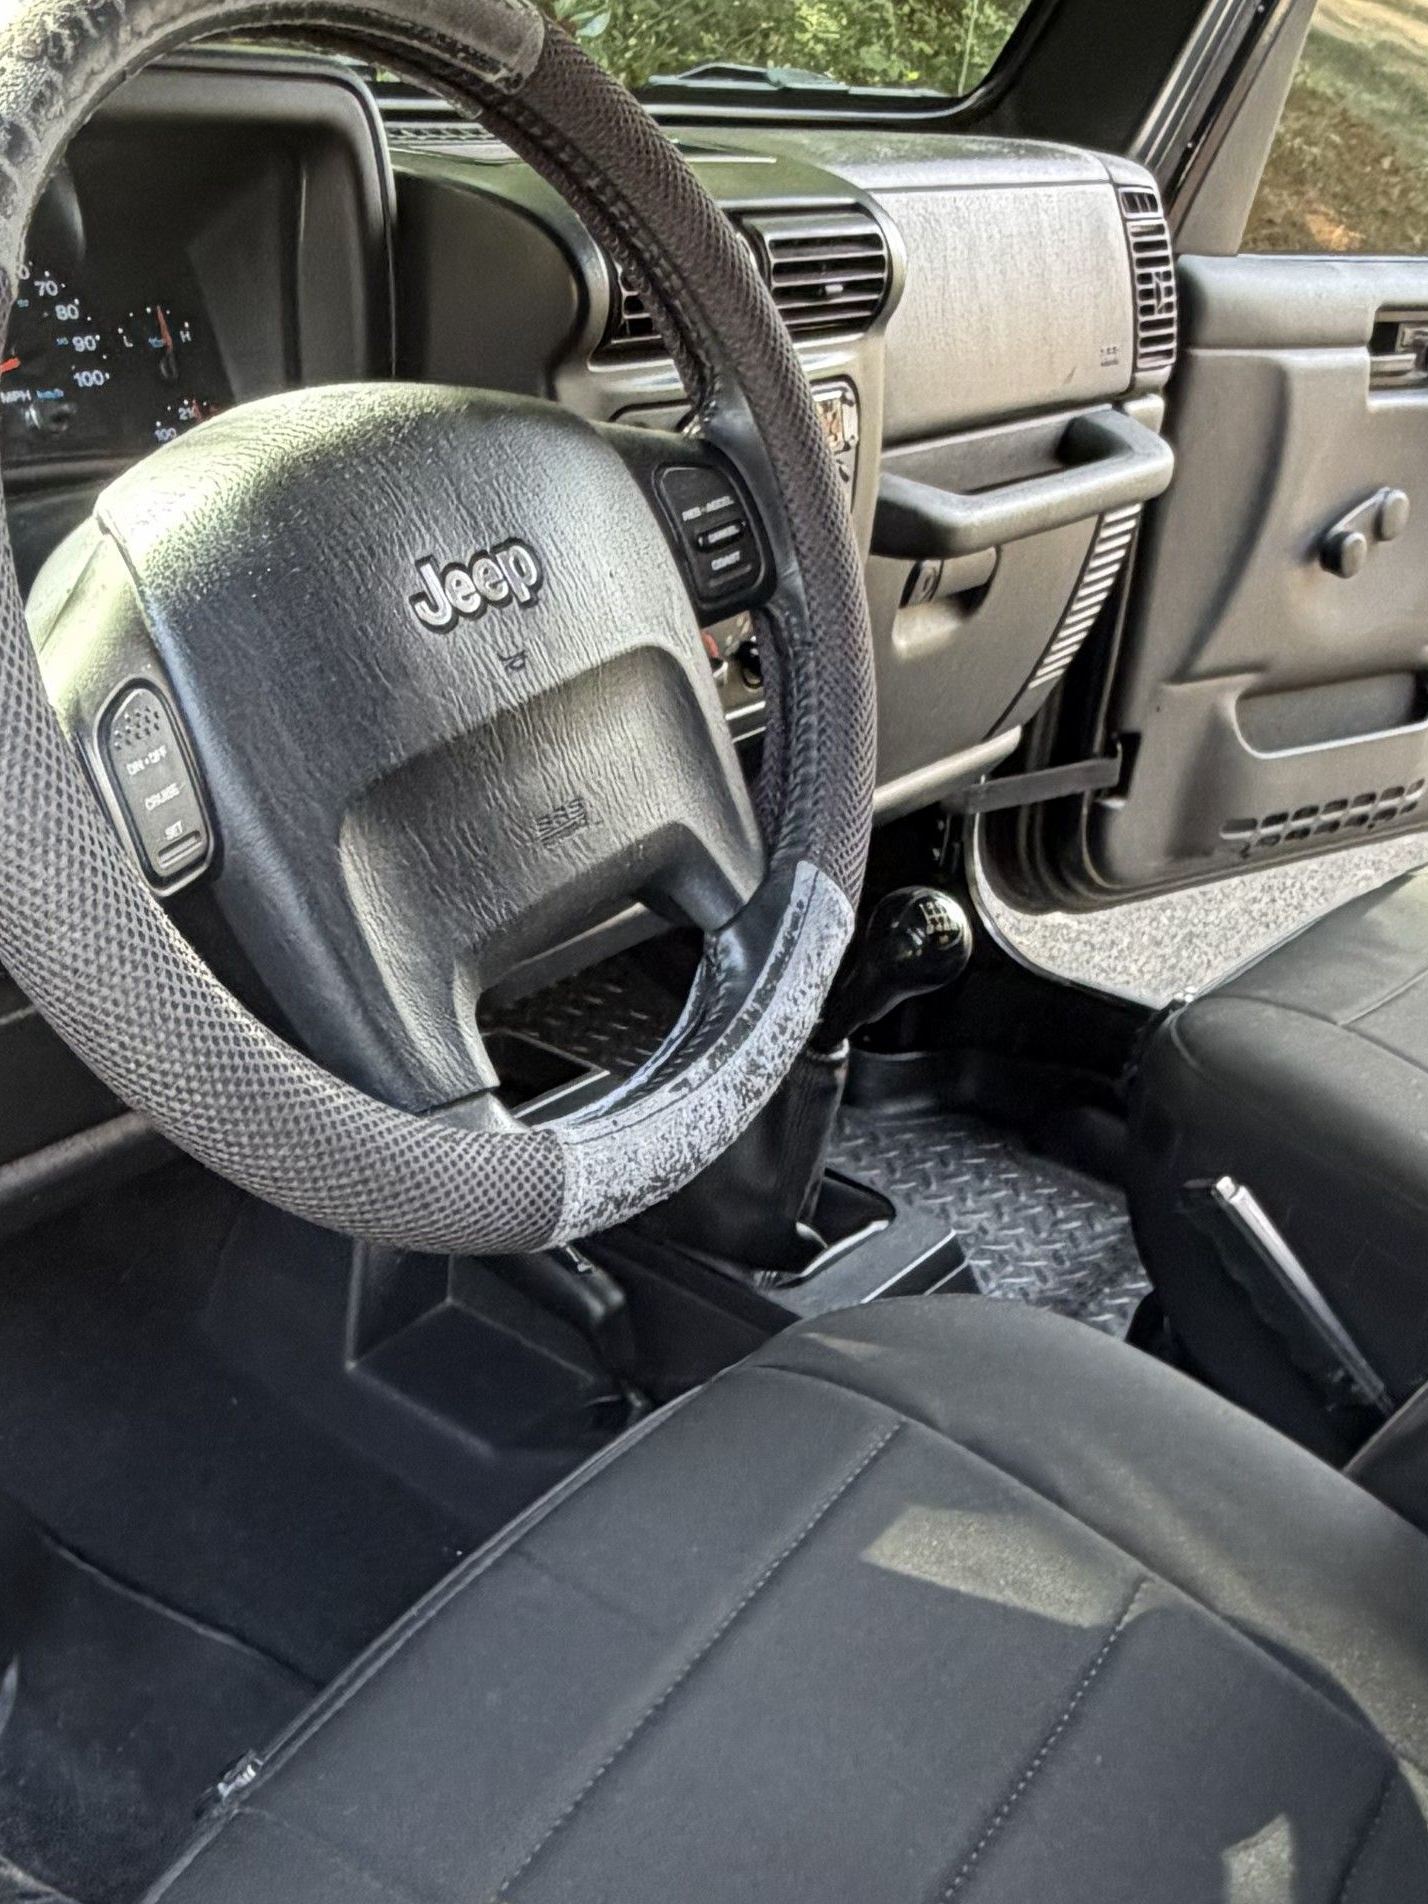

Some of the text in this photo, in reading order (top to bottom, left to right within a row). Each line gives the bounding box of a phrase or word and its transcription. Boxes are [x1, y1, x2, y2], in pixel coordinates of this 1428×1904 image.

[34, 281, 58, 296] 70
[55, 305, 79, 321] 80
[72, 336, 97, 352] 90
[74, 370, 104, 387] 100
[414, 545, 537, 626] Jeep
[164, 820, 183, 840] SET
